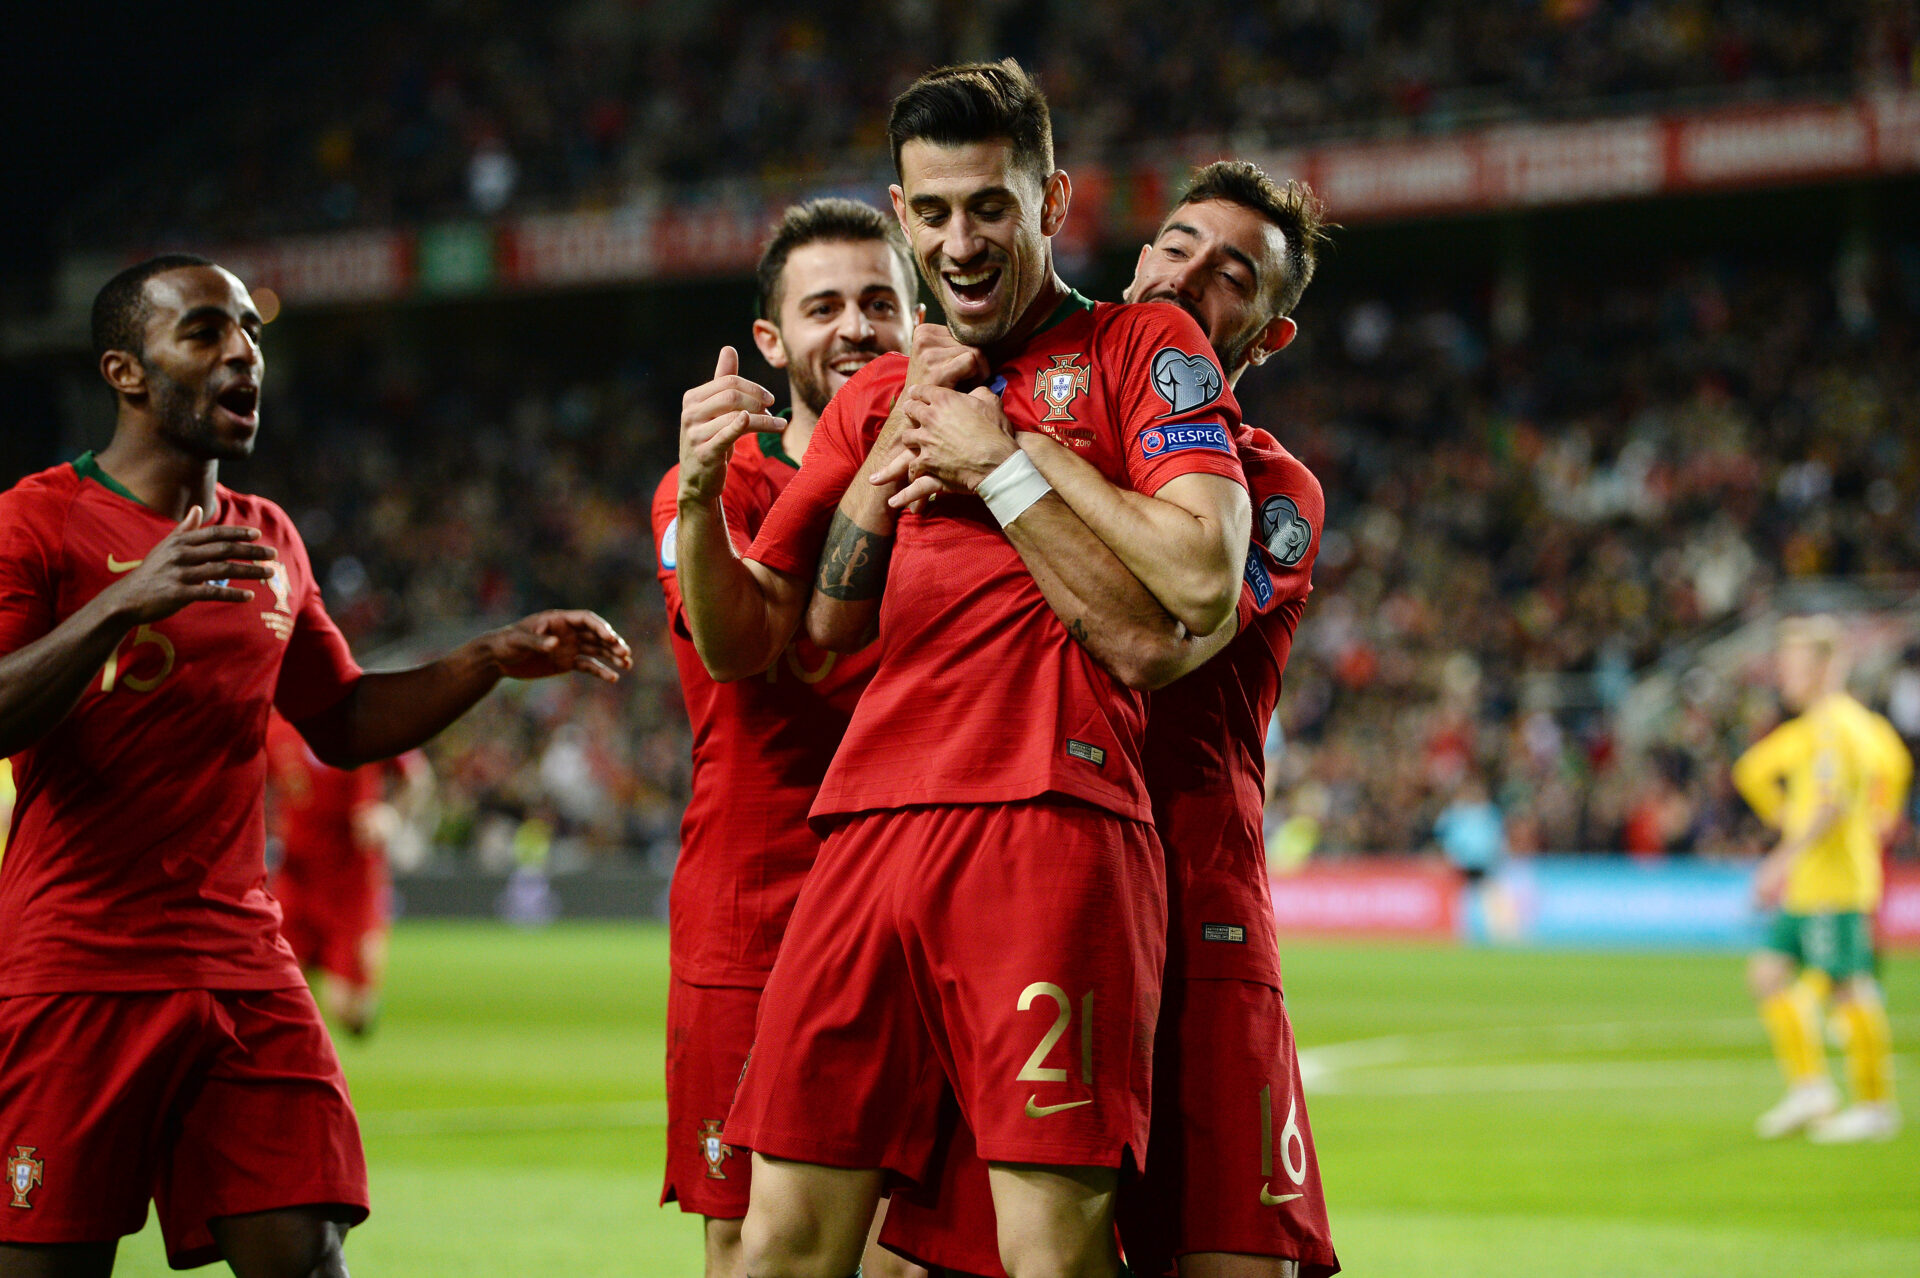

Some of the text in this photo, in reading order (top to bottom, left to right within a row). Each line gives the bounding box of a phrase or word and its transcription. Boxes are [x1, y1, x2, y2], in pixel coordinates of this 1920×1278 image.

[1038, 424, 1056, 433] TUGA
[1167, 430, 1227, 446] RESPECT
[1016, 981, 1094, 1085] 21
[1259, 1083, 1306, 1186] 16
